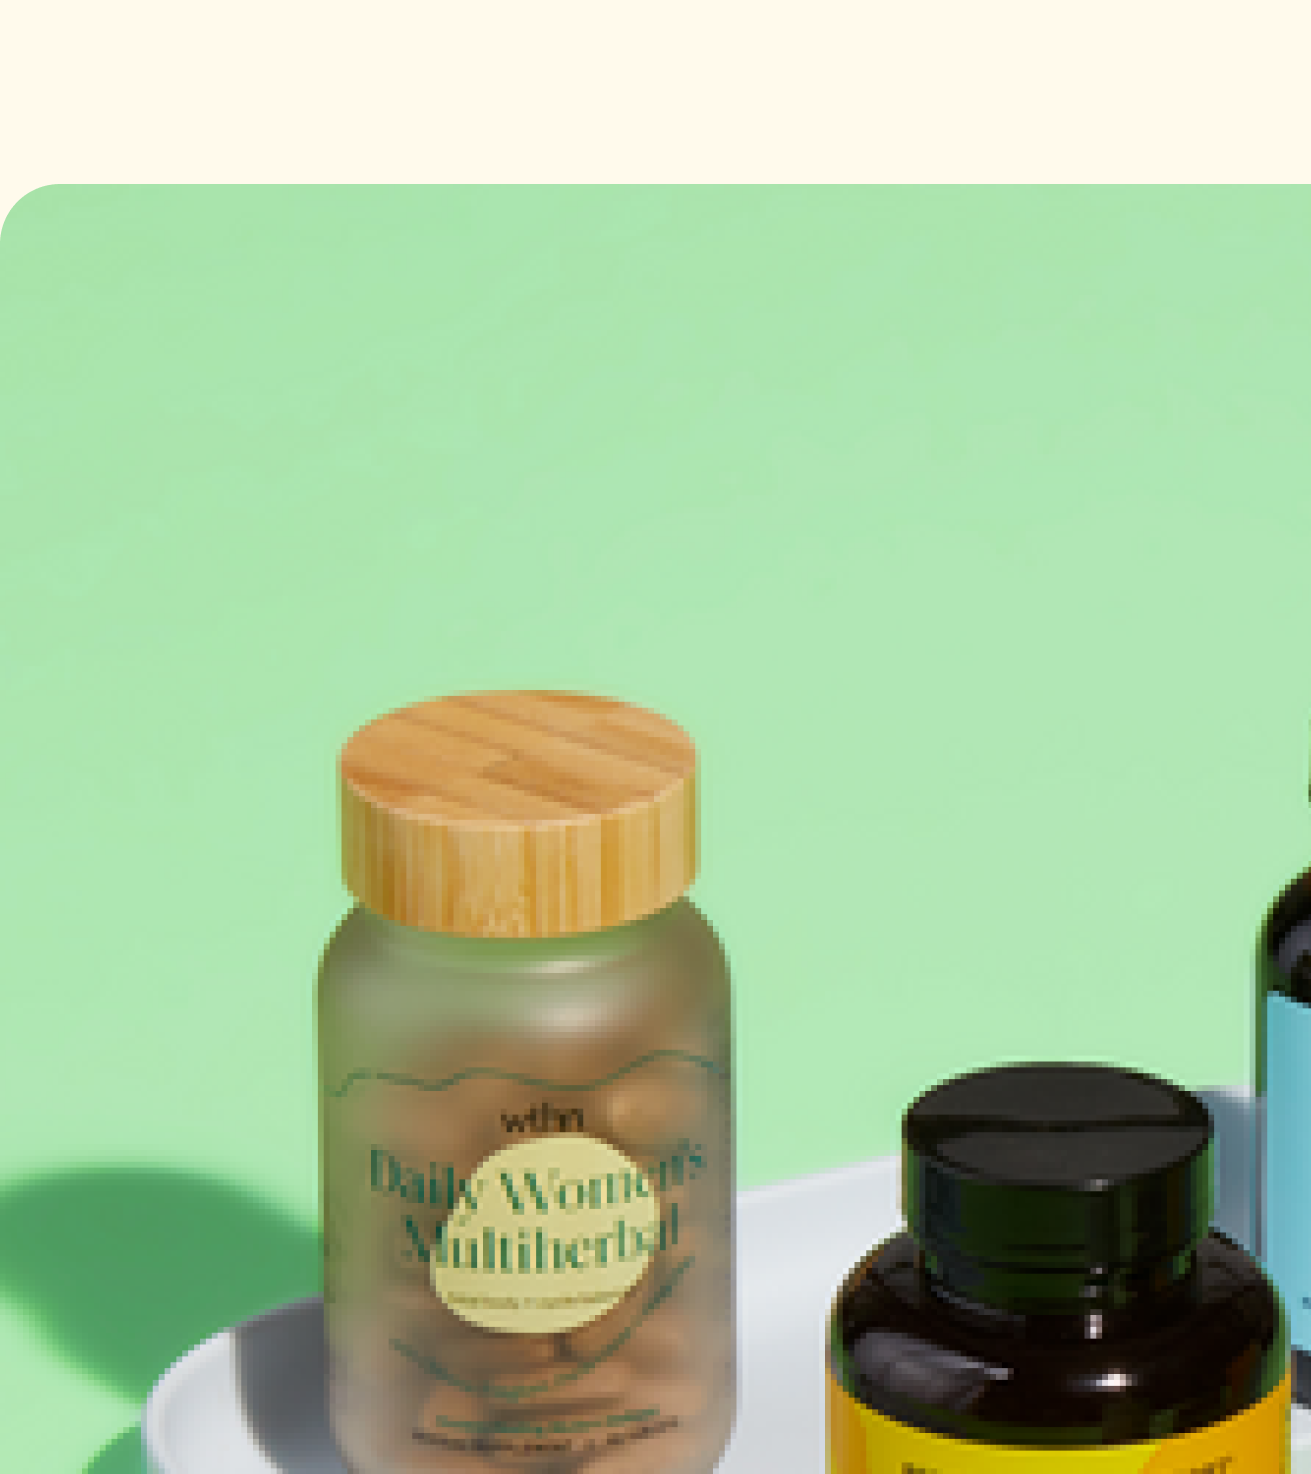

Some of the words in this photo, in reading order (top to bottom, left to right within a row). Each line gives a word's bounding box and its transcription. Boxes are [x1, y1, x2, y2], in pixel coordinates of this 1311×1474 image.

[370, 1145, 486, 1226] Daily
[499, 1138, 707, 1214] Women's
[402, 1202, 681, 1274] Multiherbal
